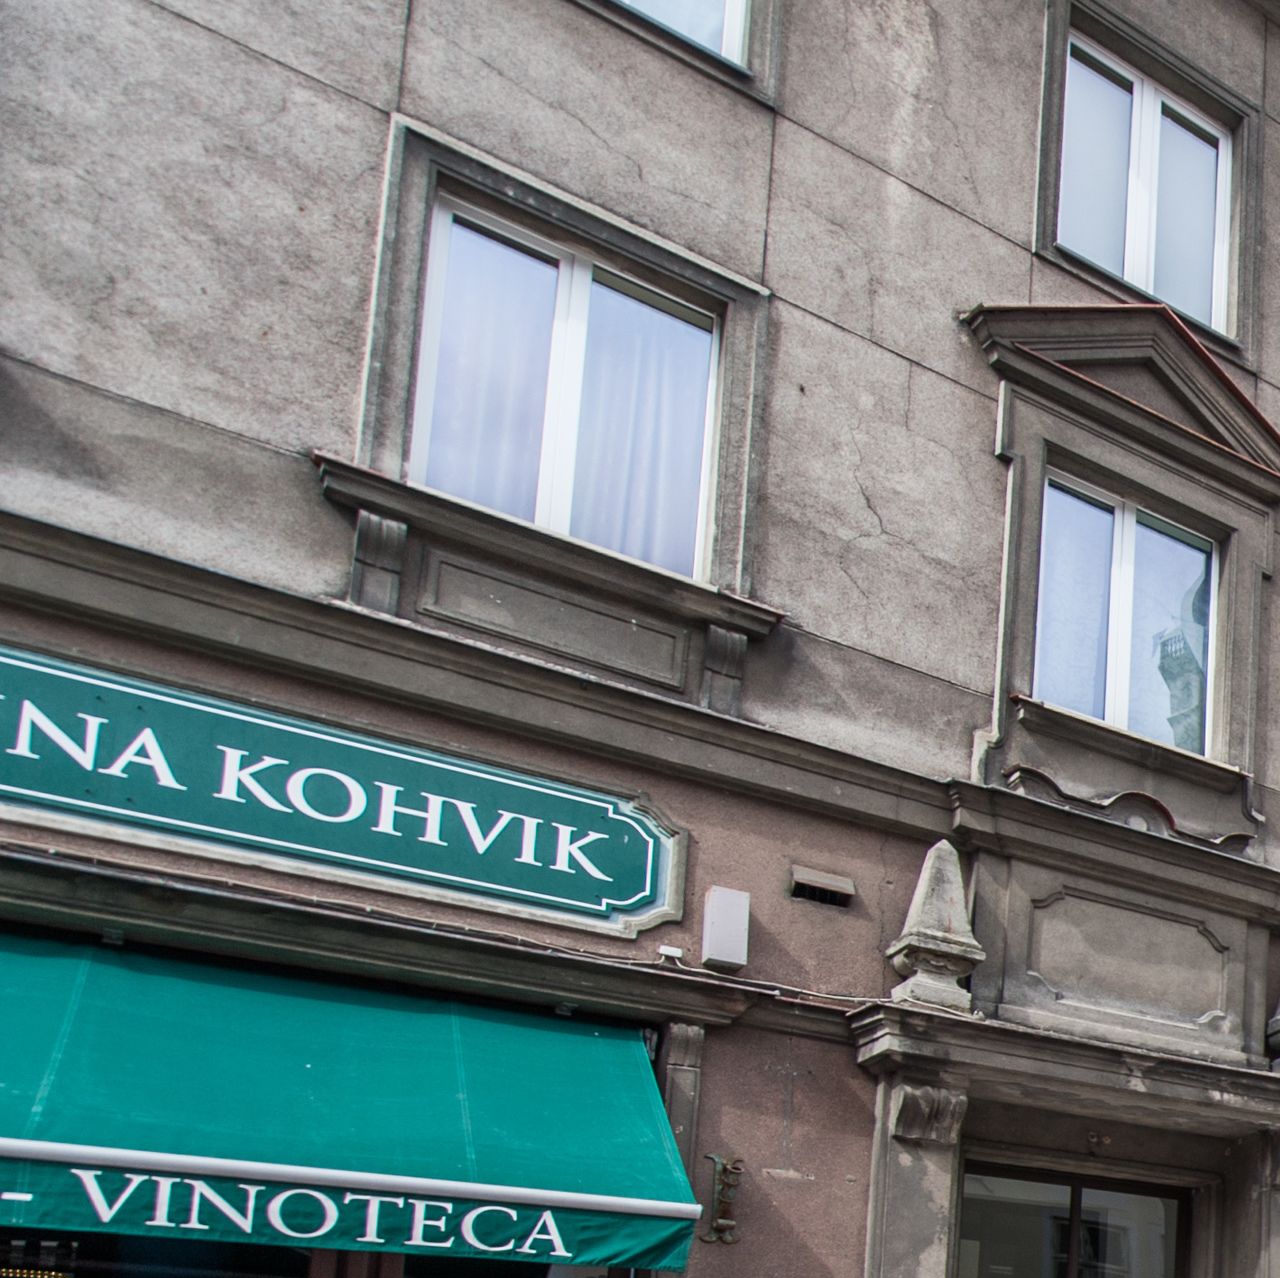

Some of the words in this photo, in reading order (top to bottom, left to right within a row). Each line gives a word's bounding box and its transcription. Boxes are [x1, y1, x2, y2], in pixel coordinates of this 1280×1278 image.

[0, 694, 188, 791] NA
[212, 744, 613, 882] KOHVIK
[70, 1168, 573, 1258] VINOTECA
